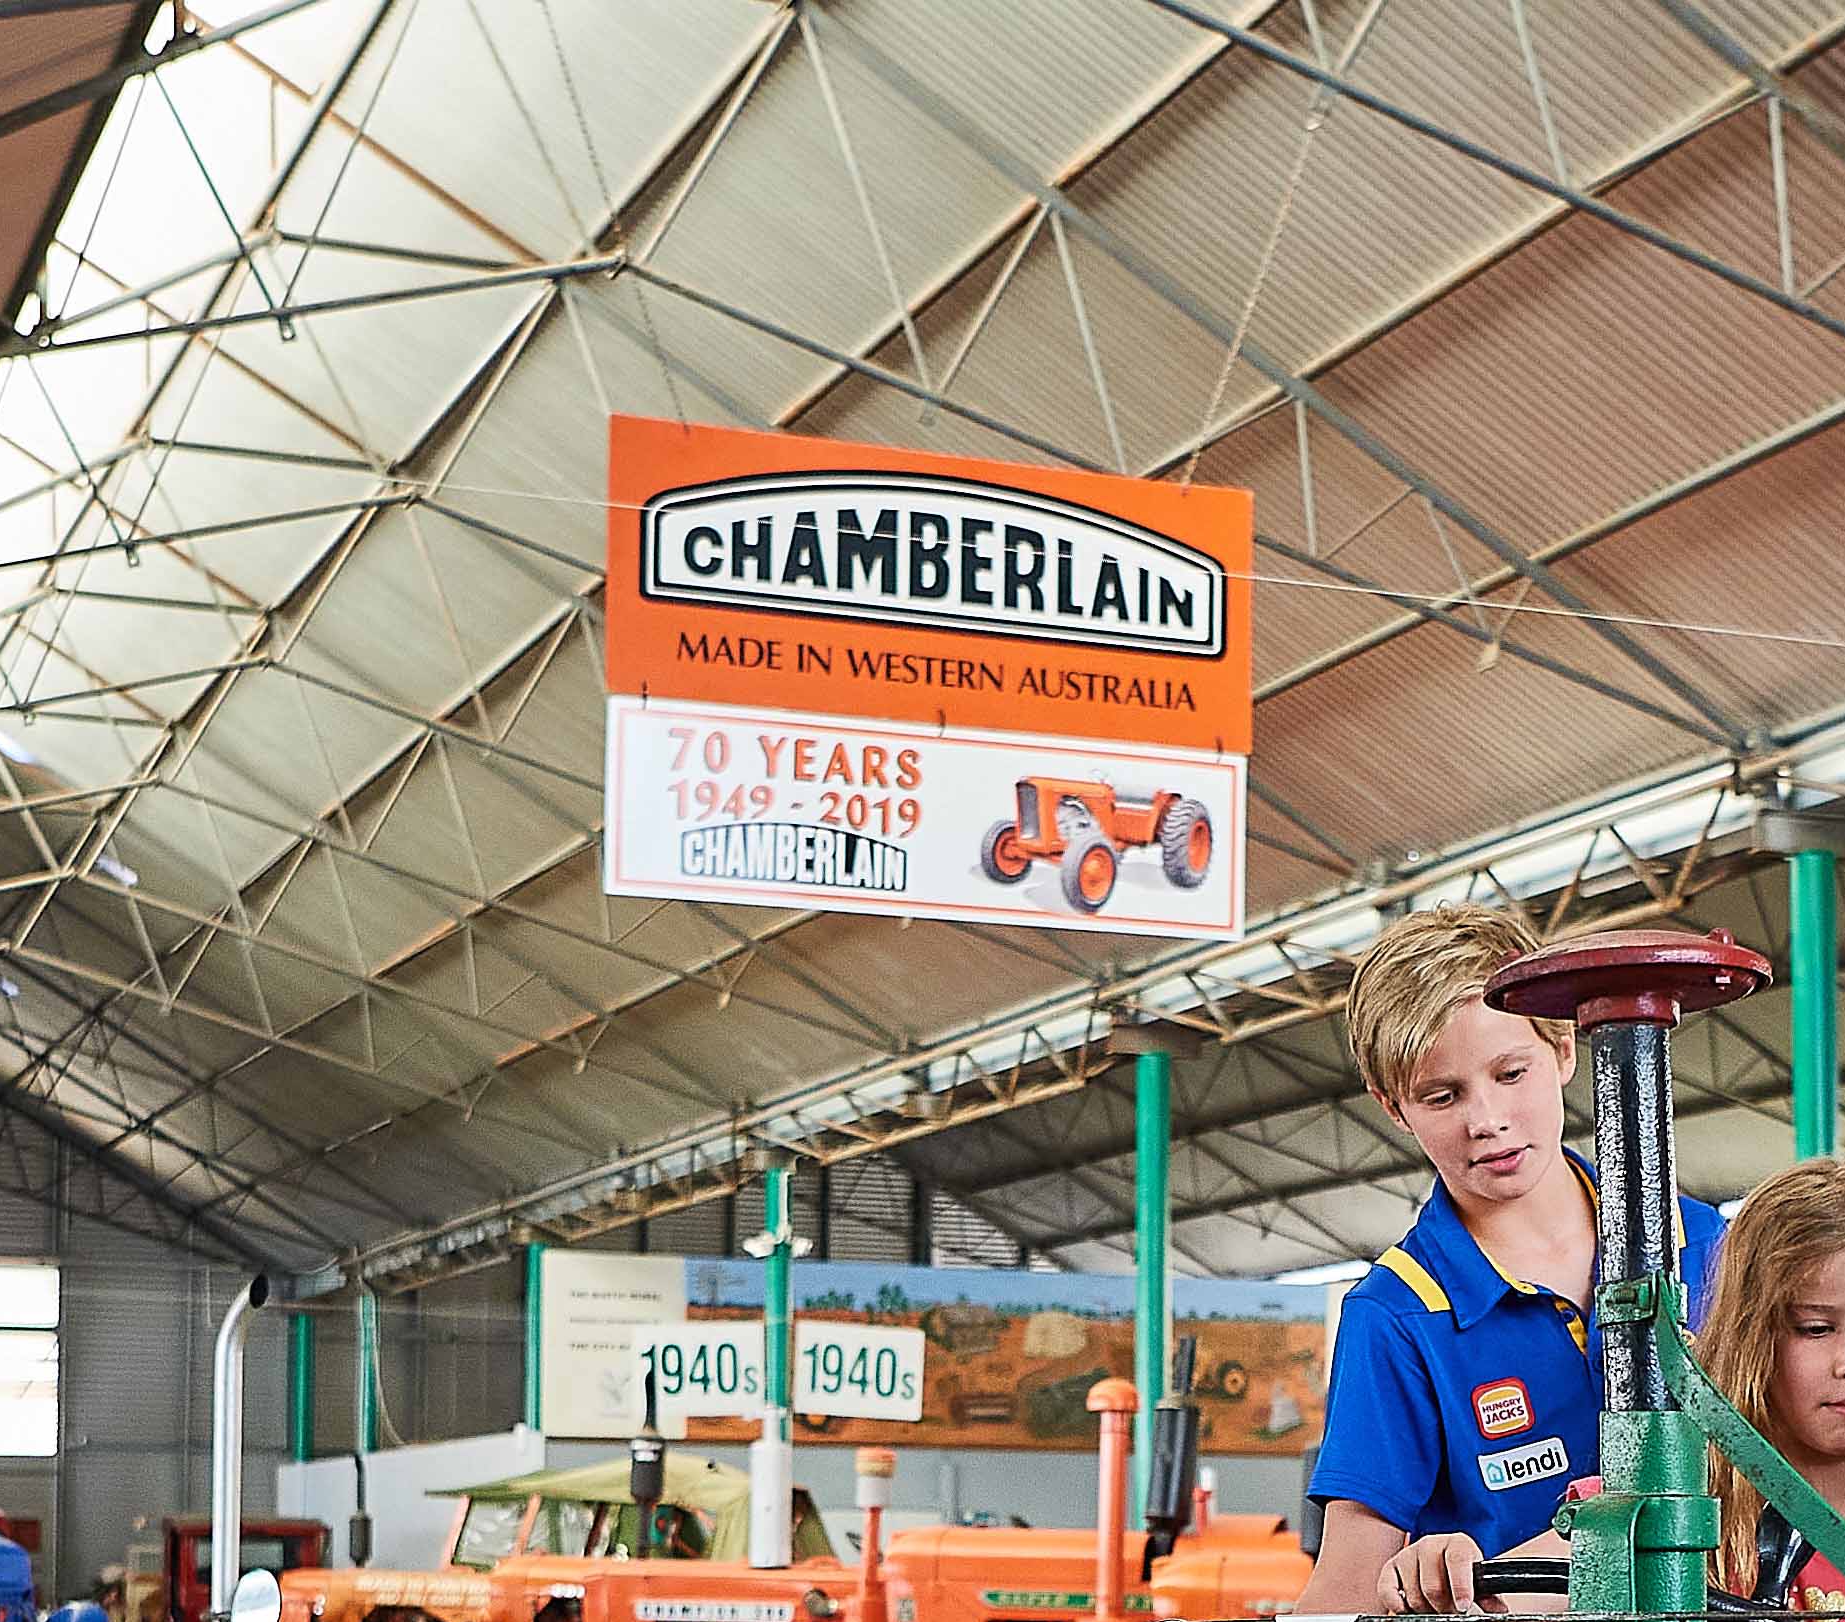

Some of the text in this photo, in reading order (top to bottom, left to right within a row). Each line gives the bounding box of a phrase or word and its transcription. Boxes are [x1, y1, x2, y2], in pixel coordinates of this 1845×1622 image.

[683, 509, 1194, 628] CHAMBERLAIN
[676, 631, 1197, 712] MADE IN WESTERN AUSTRALIA
[667, 727, 925, 790] 70 YEARS
[667, 778, 775, 824] 1949
[819, 789, 923, 838] 2019
[682, 822, 907, 891] CHAMBERLAIN
[641, 1343, 759, 1395] 1940s
[805, 1343, 916, 1401] 1940s
[1481, 1397, 1522, 1414] HUNGRY
[1503, 1446, 1563, 1481] lendi
